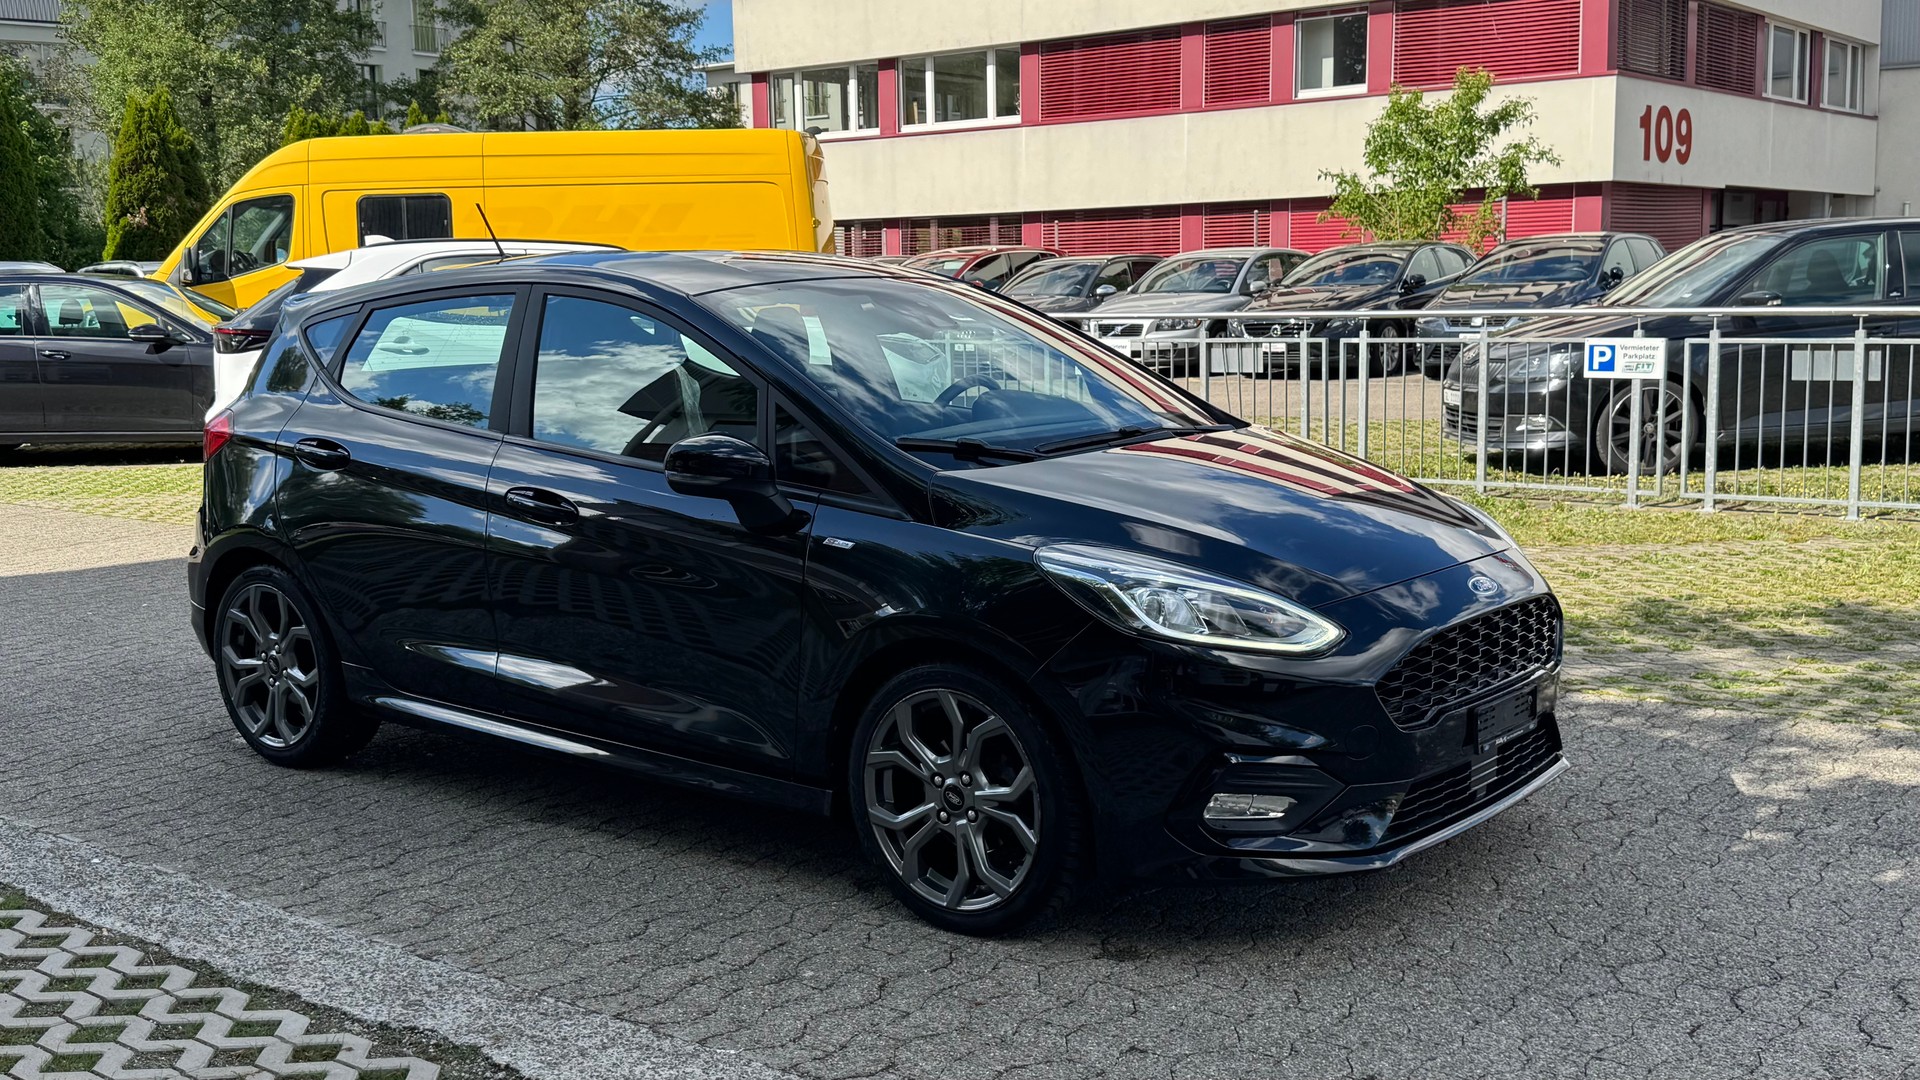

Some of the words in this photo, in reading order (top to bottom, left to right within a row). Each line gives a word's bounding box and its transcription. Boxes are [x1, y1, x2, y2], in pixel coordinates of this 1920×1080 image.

[1639, 104, 1693, 165] 109
[1592, 345, 1612, 370] P
[1622, 352, 1656, 360] Parkplatz
[1634, 363, 1652, 371] FIT
